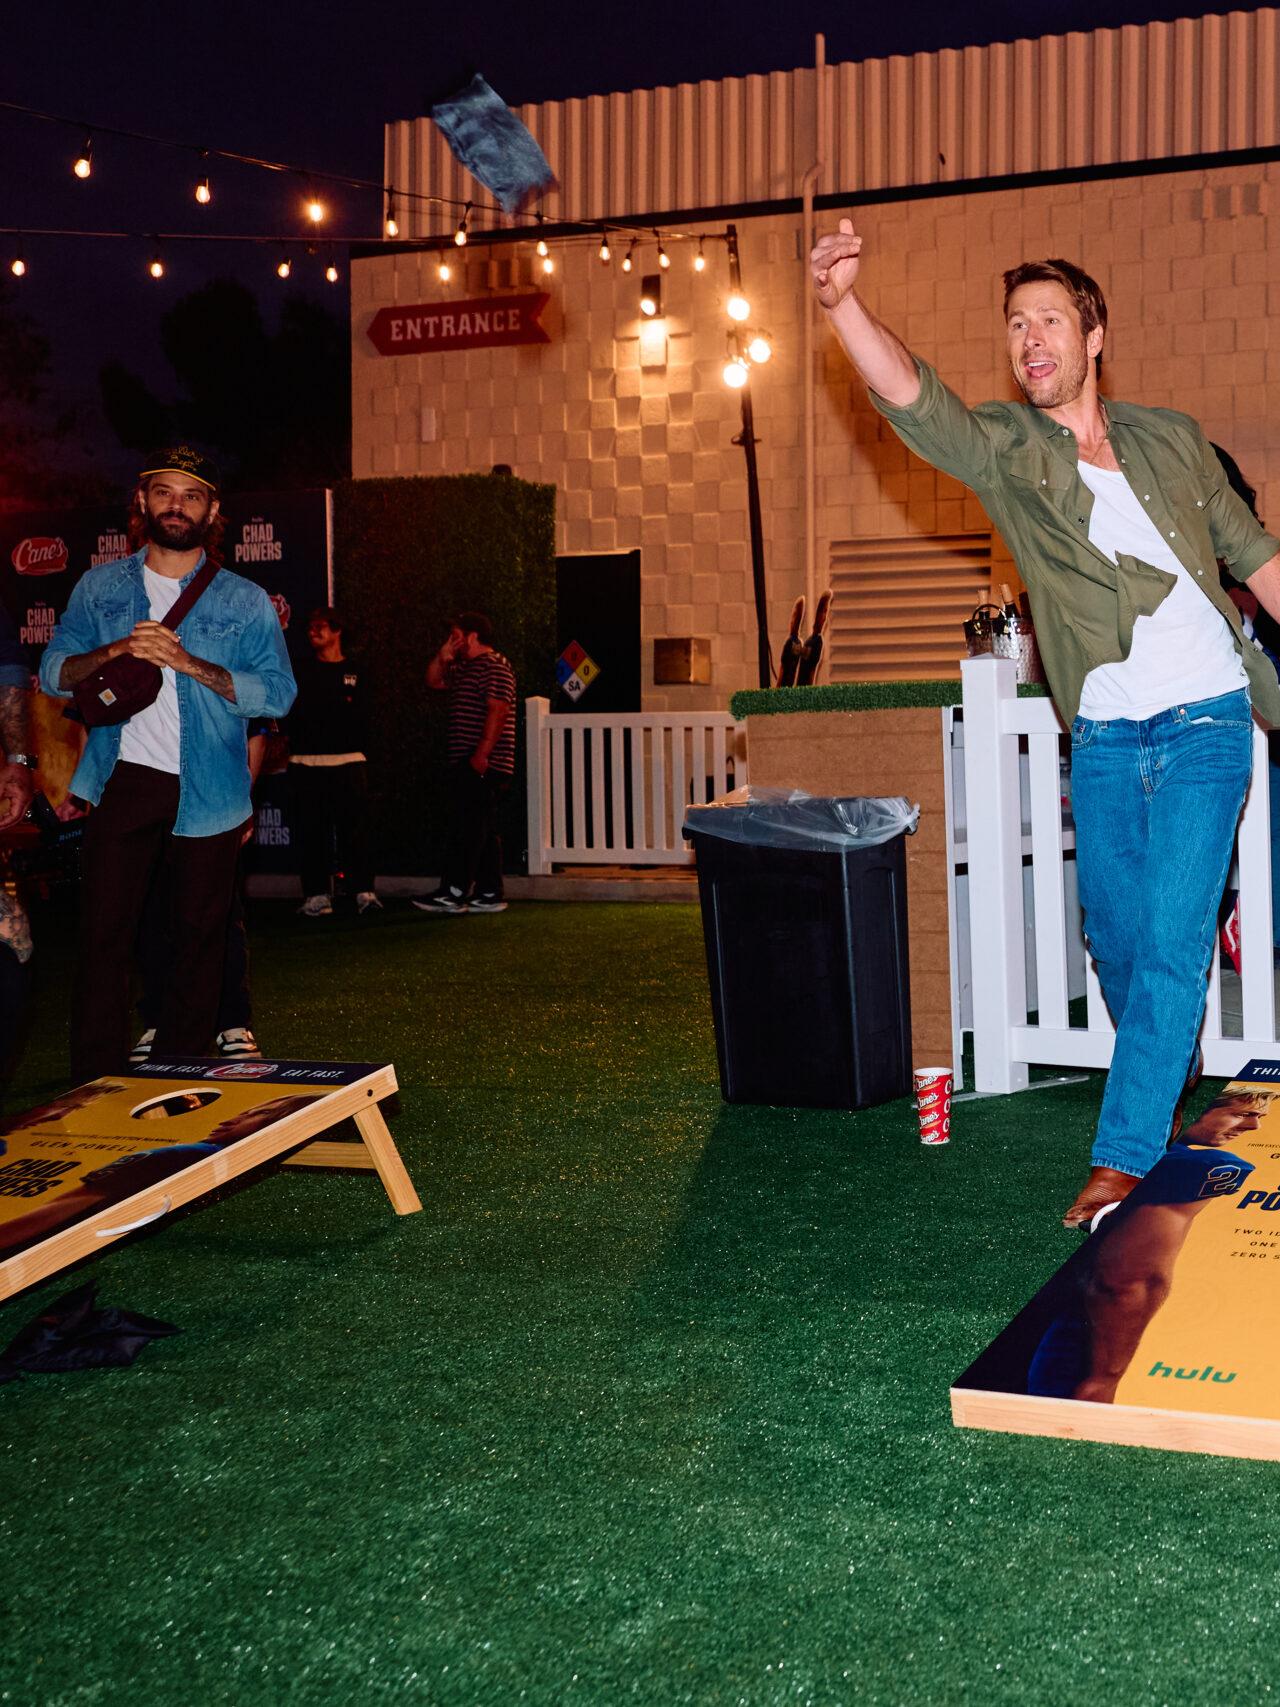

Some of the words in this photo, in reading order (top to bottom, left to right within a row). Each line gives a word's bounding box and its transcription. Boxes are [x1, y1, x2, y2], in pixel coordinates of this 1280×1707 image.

[390, 308, 521, 342] ENTRANCE
[242, 523, 274, 542] CHAD
[97, 533, 128, 553] CHAD
[234, 541, 283, 563] POWERS
[15, 536, 66, 572] Cane's
[27, 607, 56, 626] CHAD
[583, 664, 590, 676] 0
[568, 680, 581, 691] SA
[258, 808, 282, 827] HAD
[280, 1069, 310, 1077] EAT
[30, 1140, 72, 1148] GLEN
[74, 1143, 137, 1152] POWELL
[1199, 1164, 1242, 1198] 2
[1233, 1228, 1263, 1236] TWO
[1249, 1241, 1280, 1249] ONE
[1230, 1251, 1267, 1260] ZERO
[1147, 1361, 1238, 1384] hulu
